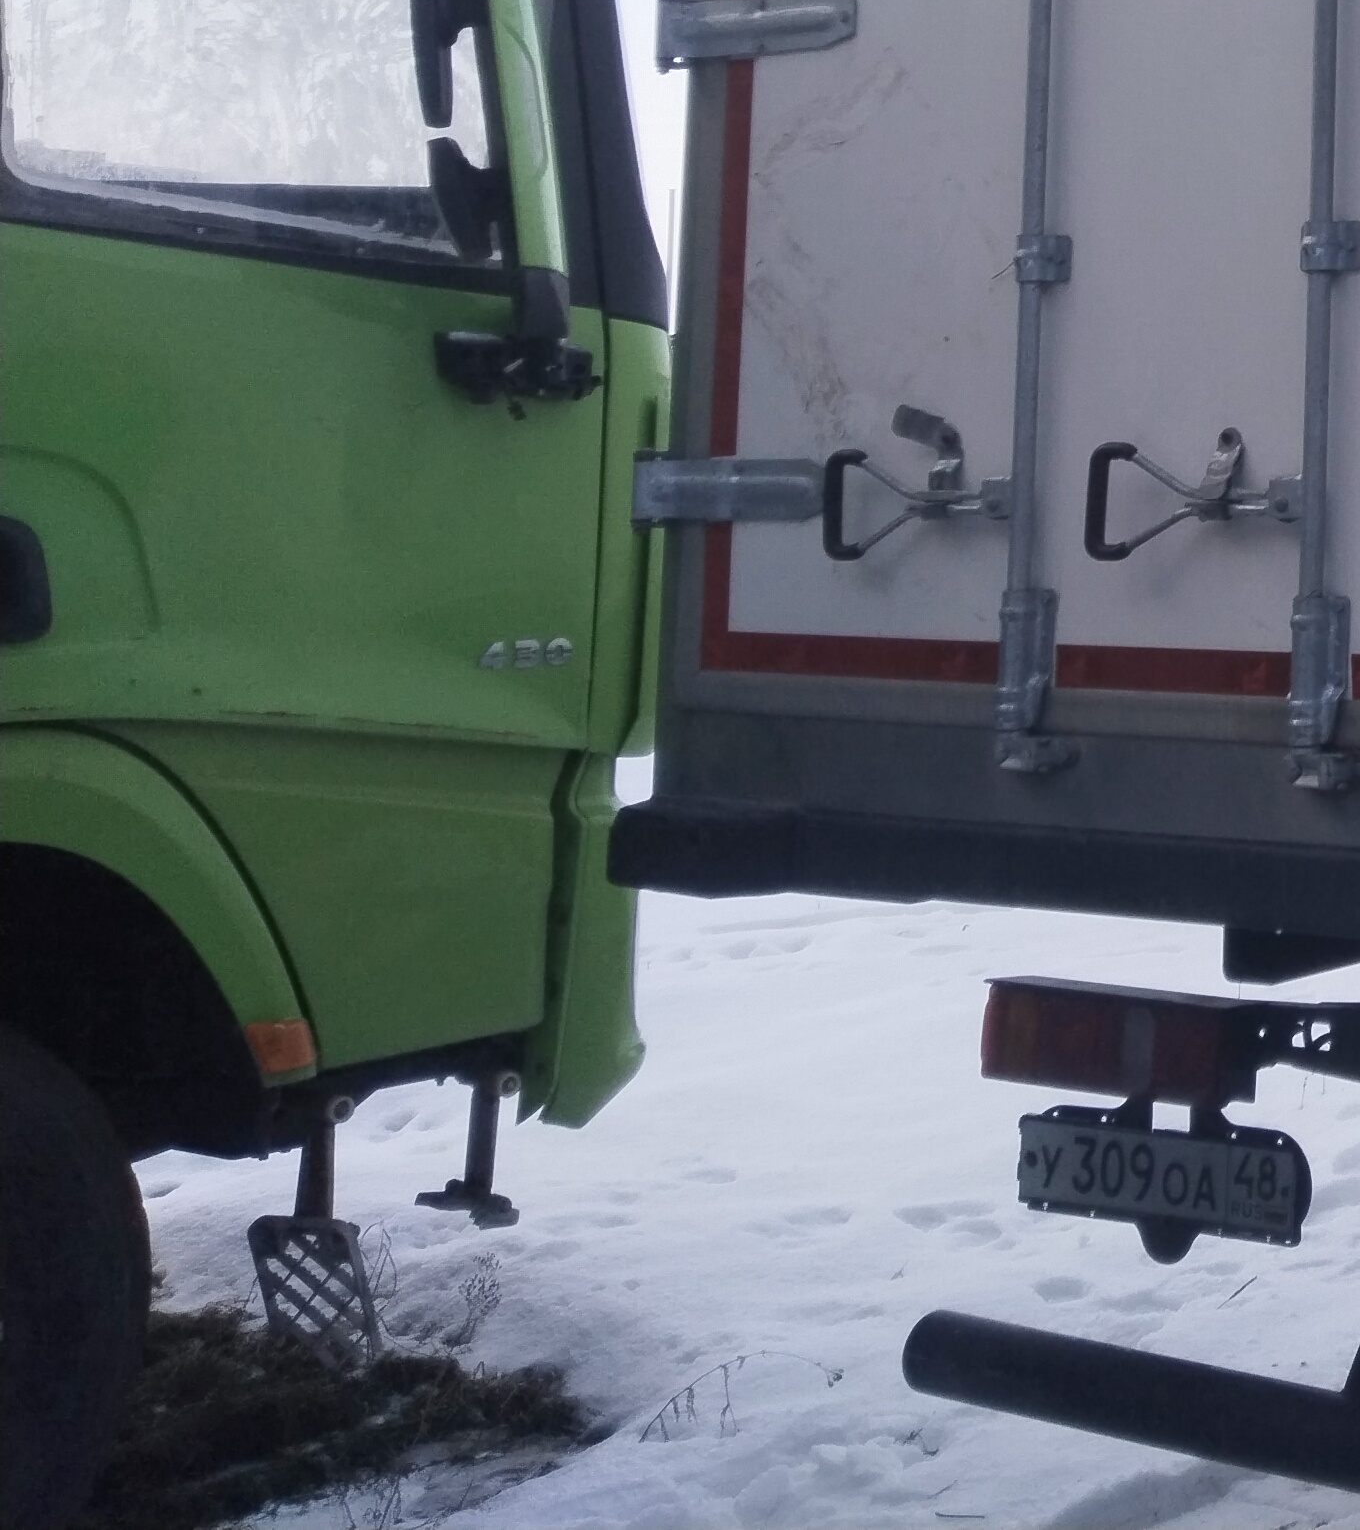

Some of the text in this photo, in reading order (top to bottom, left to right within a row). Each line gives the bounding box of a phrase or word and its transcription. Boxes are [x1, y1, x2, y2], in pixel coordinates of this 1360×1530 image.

[478, 637, 573, 671] 430
[1234, 1151, 1277, 1202] 48
[1231, 1200, 1264, 1222] RUS
